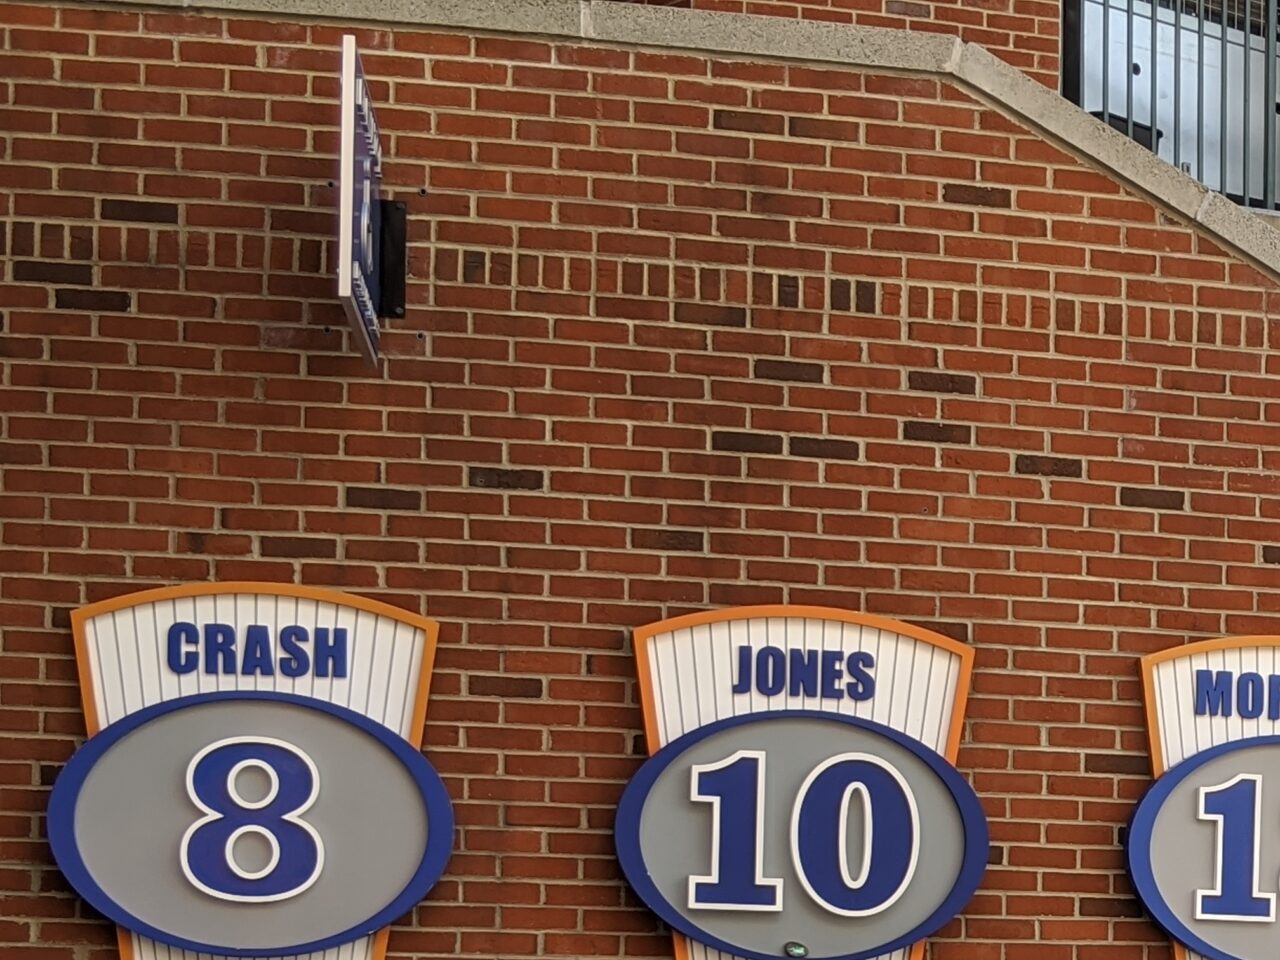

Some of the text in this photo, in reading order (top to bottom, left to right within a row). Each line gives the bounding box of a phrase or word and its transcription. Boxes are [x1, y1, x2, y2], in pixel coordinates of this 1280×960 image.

[167, 621, 348, 679] CRASH
[733, 645, 876, 701] JONES
[180, 736, 325, 903] 8
[687, 750, 921, 917] 10
